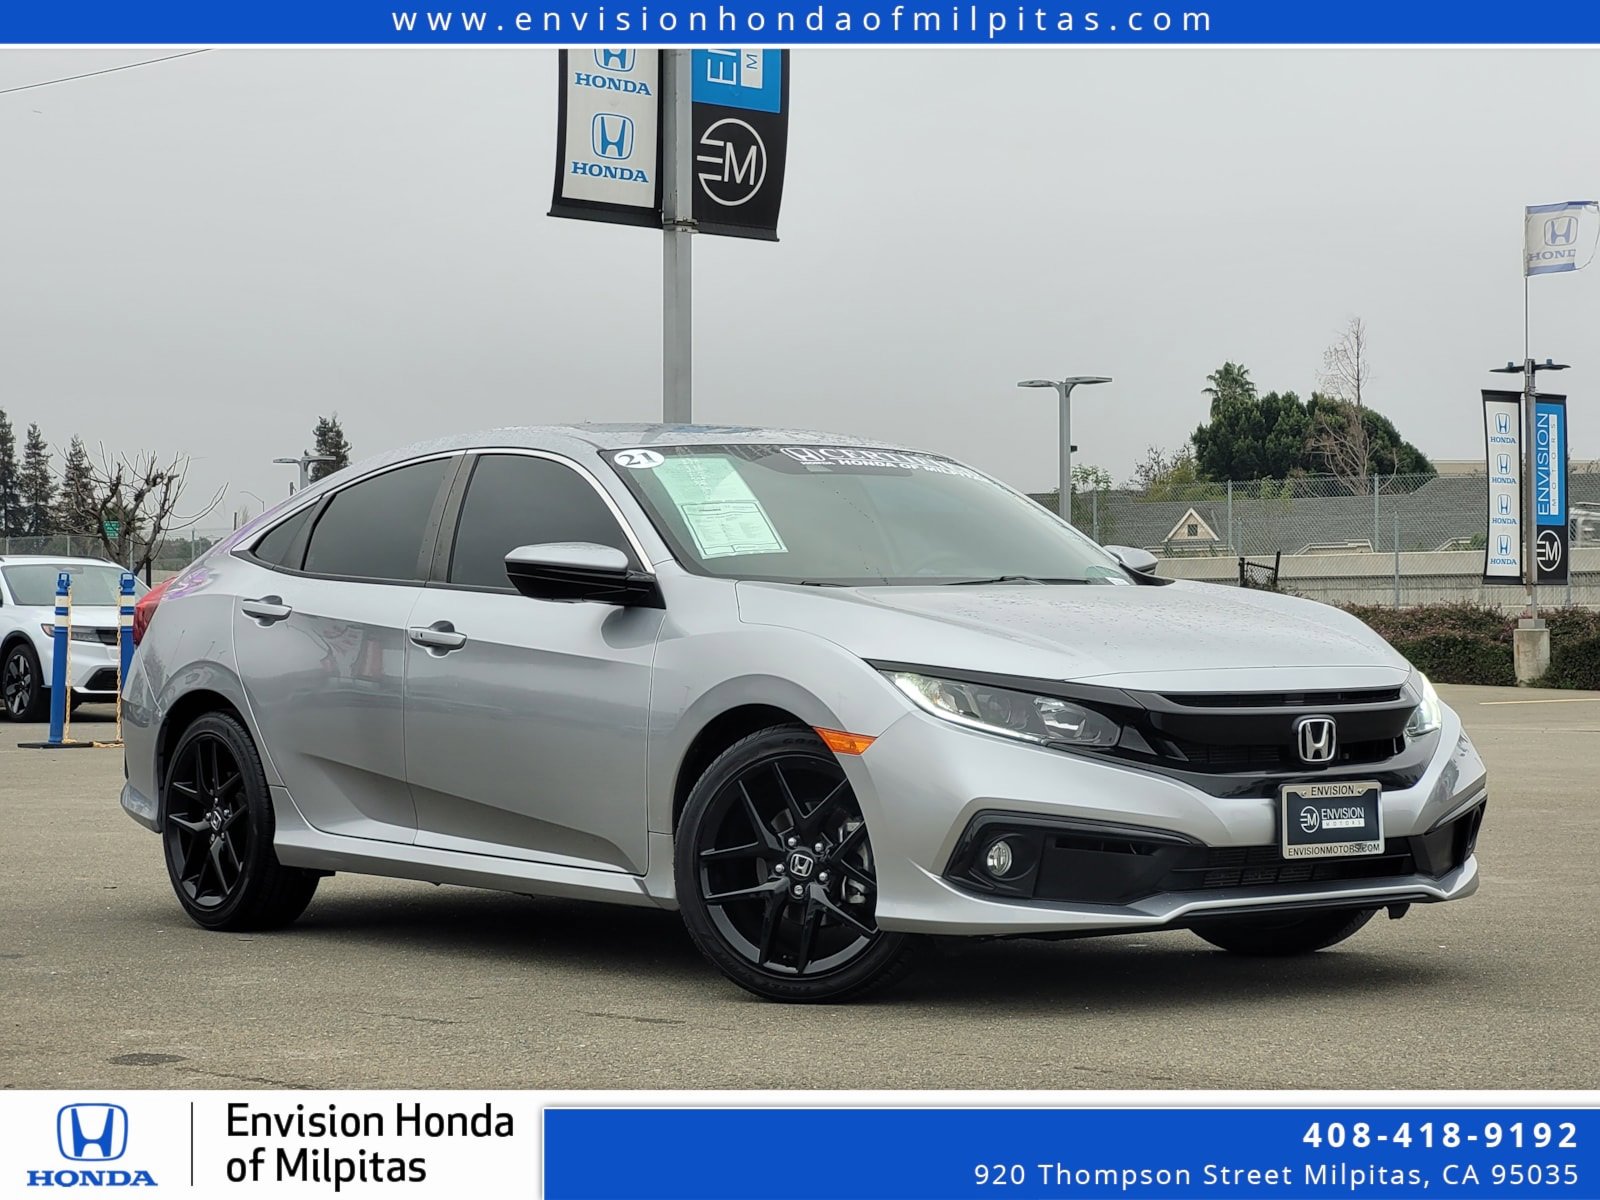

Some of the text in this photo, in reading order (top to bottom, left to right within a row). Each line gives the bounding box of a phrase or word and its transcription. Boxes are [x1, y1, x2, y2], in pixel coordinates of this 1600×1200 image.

[574, 72, 652, 96] HONDA
[571, 161, 649, 183] HONDA
[1490, 436, 1517, 445] HONDA
[618, 452, 656, 466] 21
[838, 459, 897, 468] HONDA
[899, 463, 921, 471] OF
[1537, 413, 1549, 515] ENVISION
[1491, 477, 1517, 485] HONDA
[1491, 517, 1517, 525] HONDA
[1490, 558, 1517, 566] HONDA
[1311, 785, 1355, 796] ENVISION
[1321, 807, 1365, 820] ENVISION
[1288, 843, 1380, 857] ENVISIONMOTORS.COM
